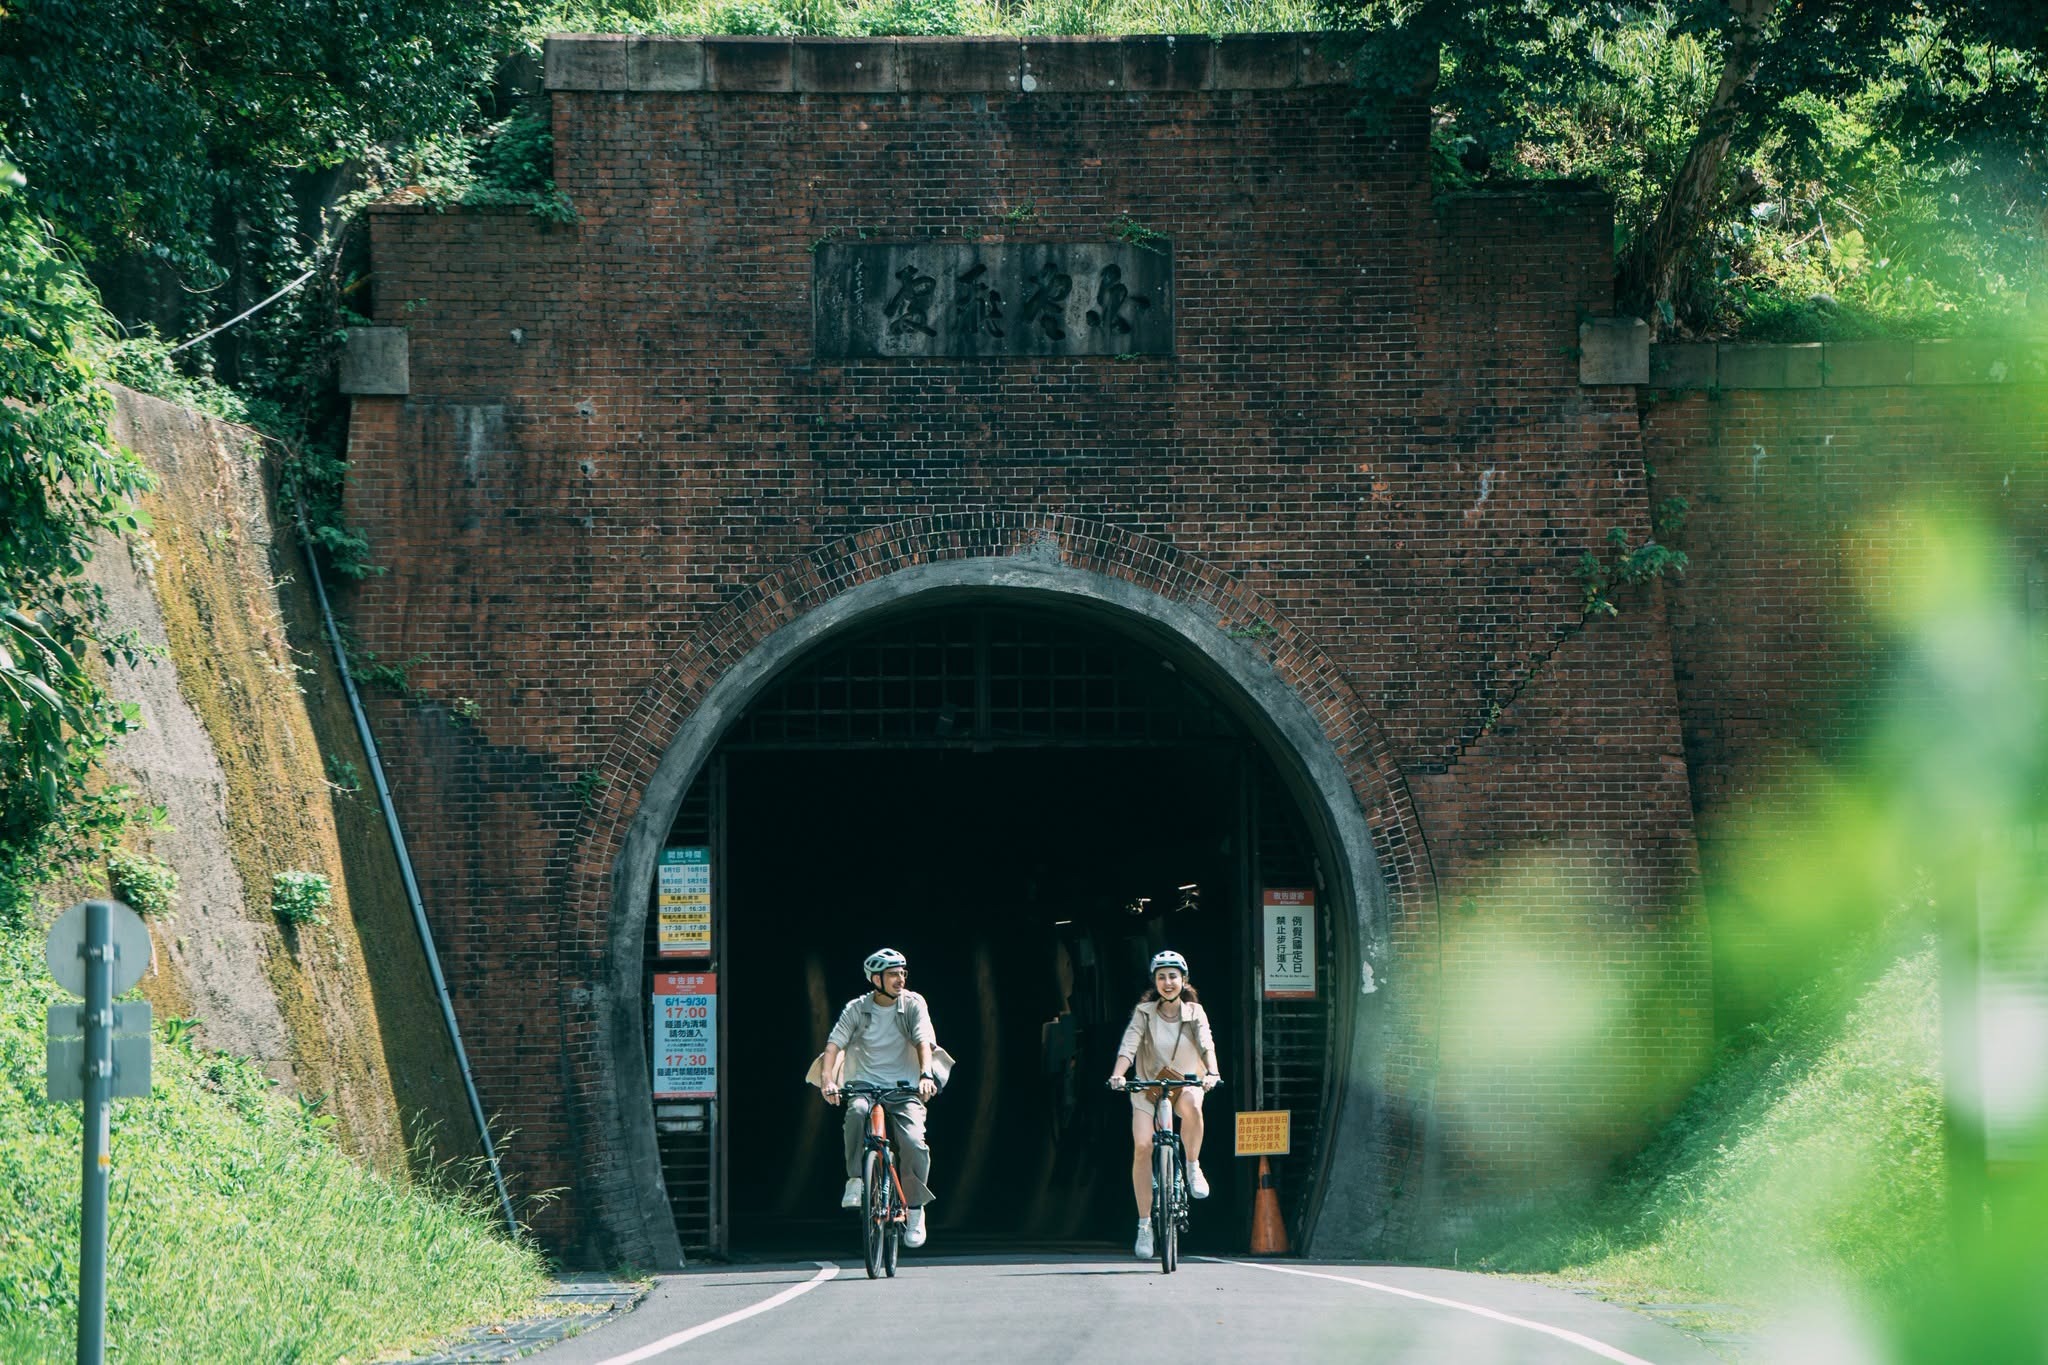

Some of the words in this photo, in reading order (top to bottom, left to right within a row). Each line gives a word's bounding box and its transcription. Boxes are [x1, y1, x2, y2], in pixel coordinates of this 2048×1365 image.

[1276, 916, 1287, 973] 禁止步行進入
[666, 1007, 707, 1018] 17:00
[669, 1029, 704, 1038] 請勿進入
[666, 1054, 707, 1066] 17:30
